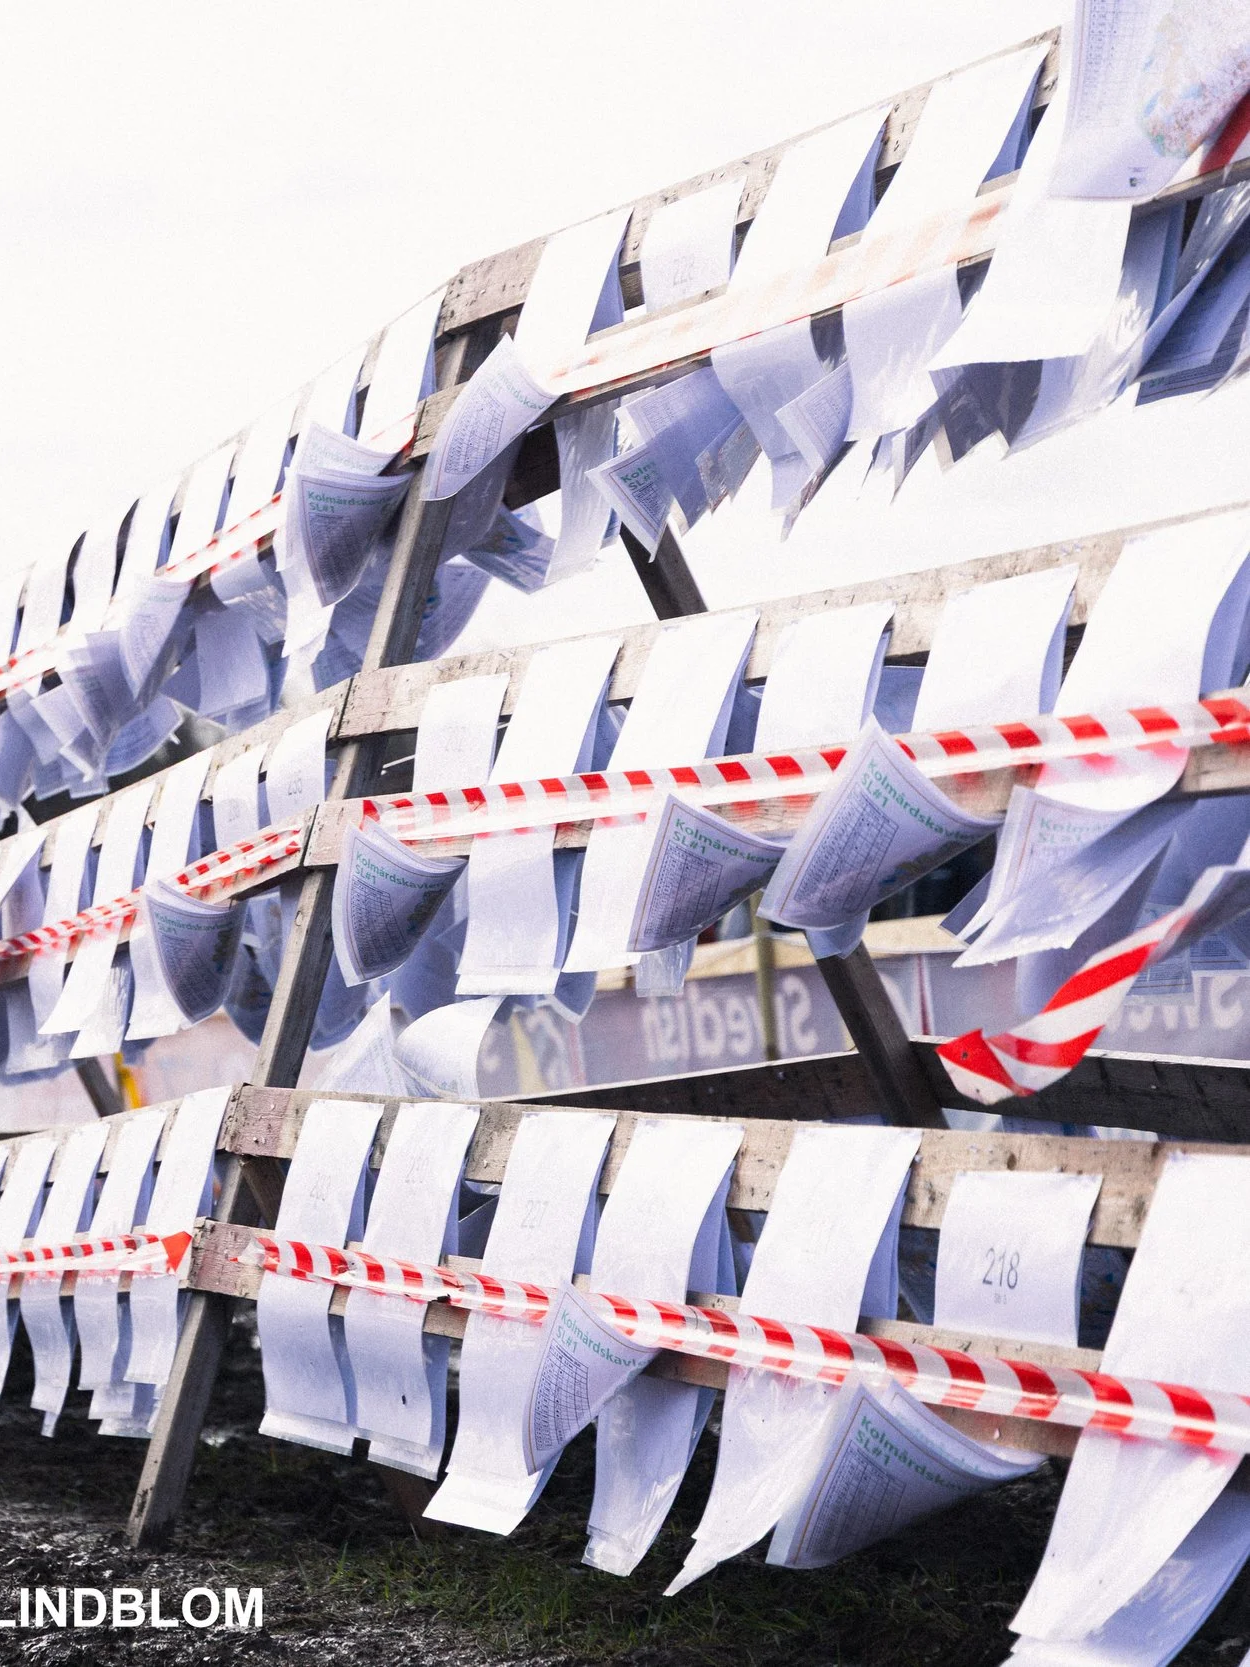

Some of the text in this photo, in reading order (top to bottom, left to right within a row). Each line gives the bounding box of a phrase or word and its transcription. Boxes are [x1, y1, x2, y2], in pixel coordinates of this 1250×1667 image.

[860, 772, 889, 808] SL#1
[672, 830, 697, 855] SL#1
[355, 863, 377, 885] SL#1
[982, 1246, 1020, 1290] 218
[556, 1325, 579, 1353] SL#1
[855, 1429, 892, 1466] SL#1
